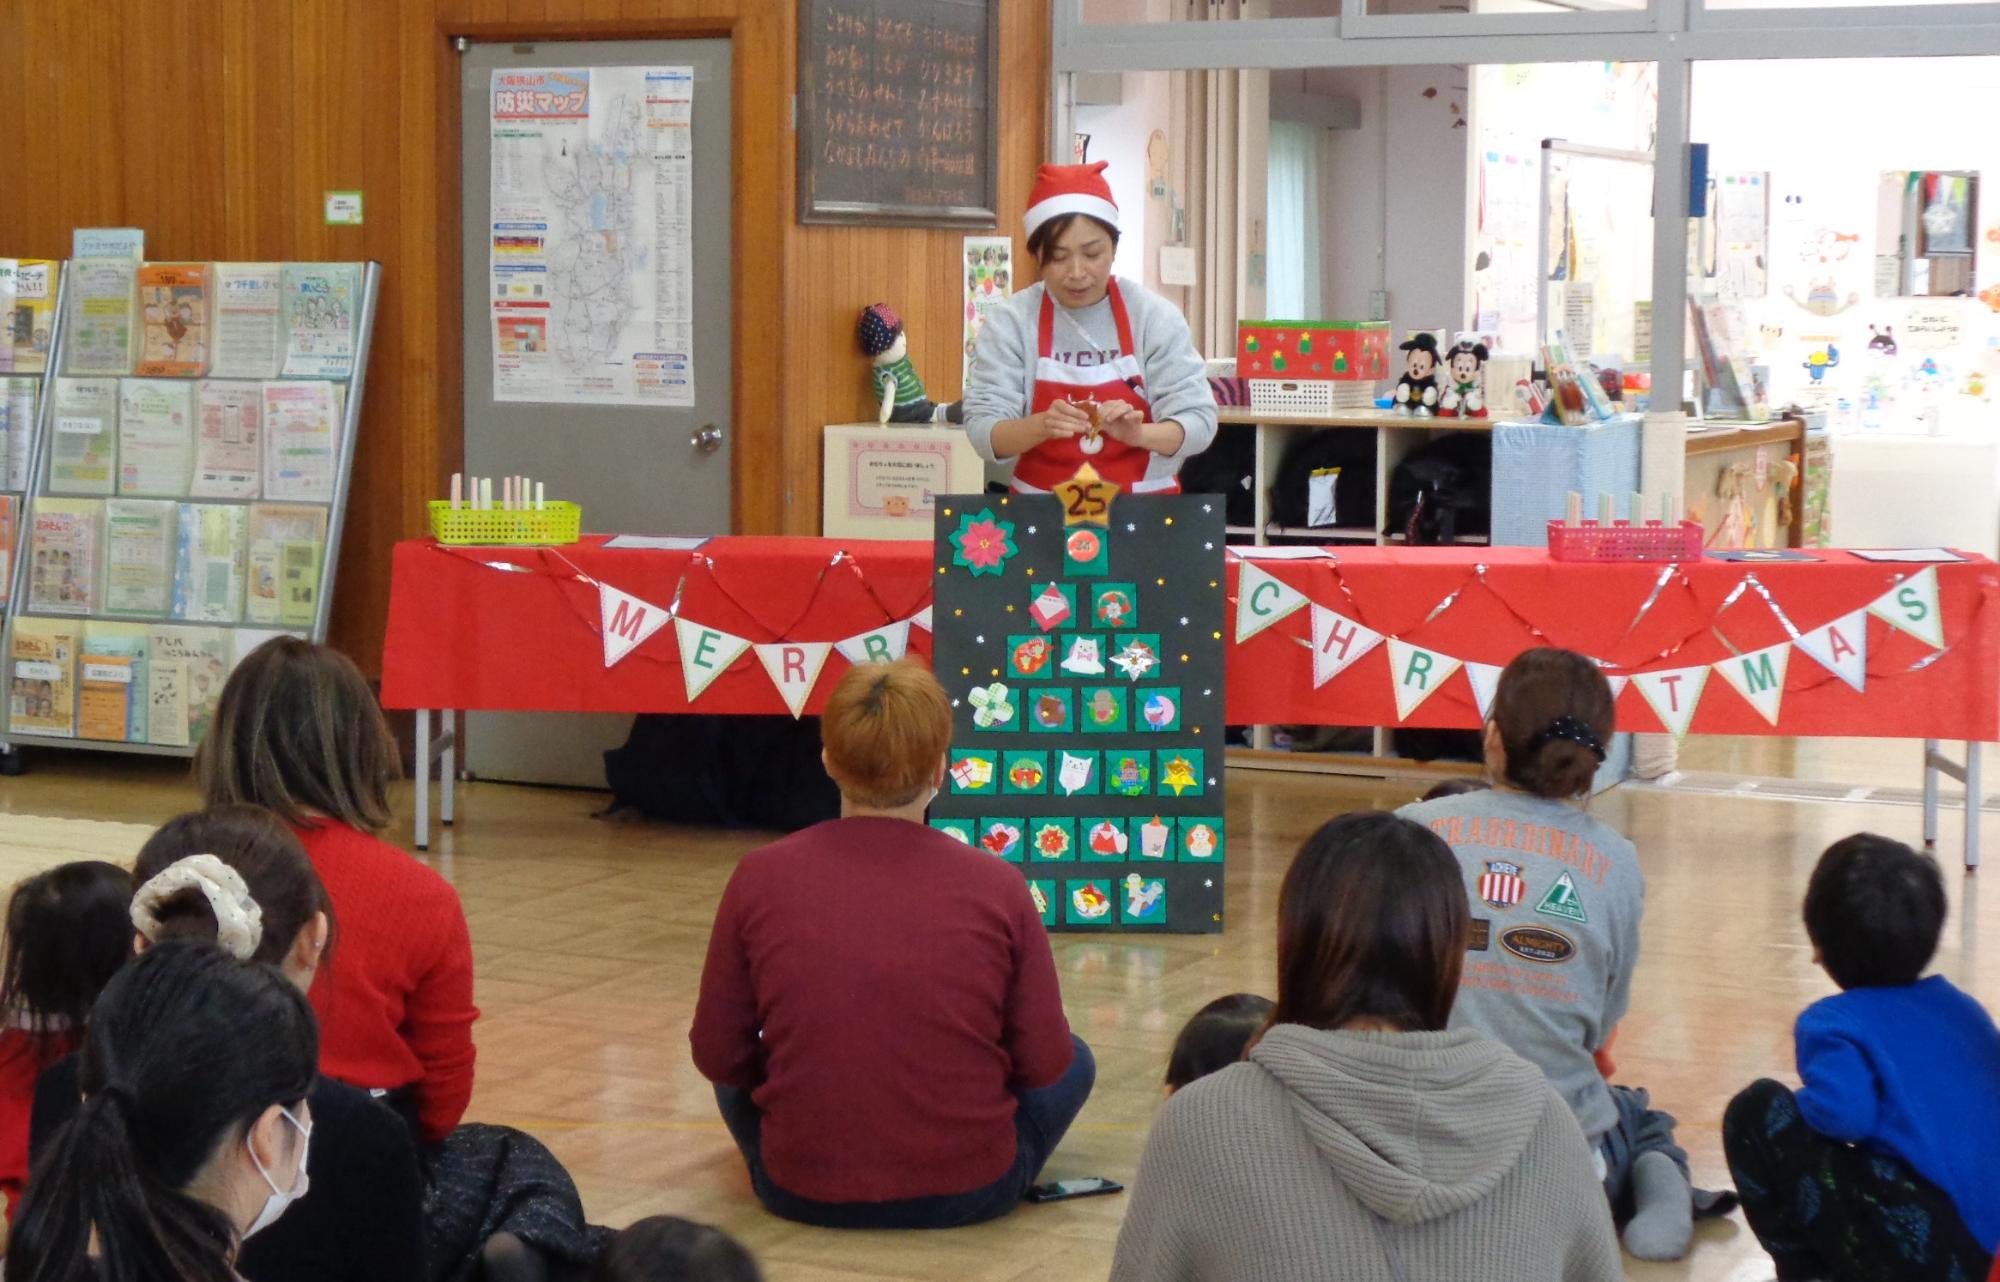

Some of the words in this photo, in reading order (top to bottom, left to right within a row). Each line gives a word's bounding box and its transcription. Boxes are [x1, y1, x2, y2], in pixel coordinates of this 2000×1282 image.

[495, 90, 588, 114] 防災マップ
[1066, 484, 1106, 516] 25
[1425, 815, 1614, 890] TRAORDINARY
